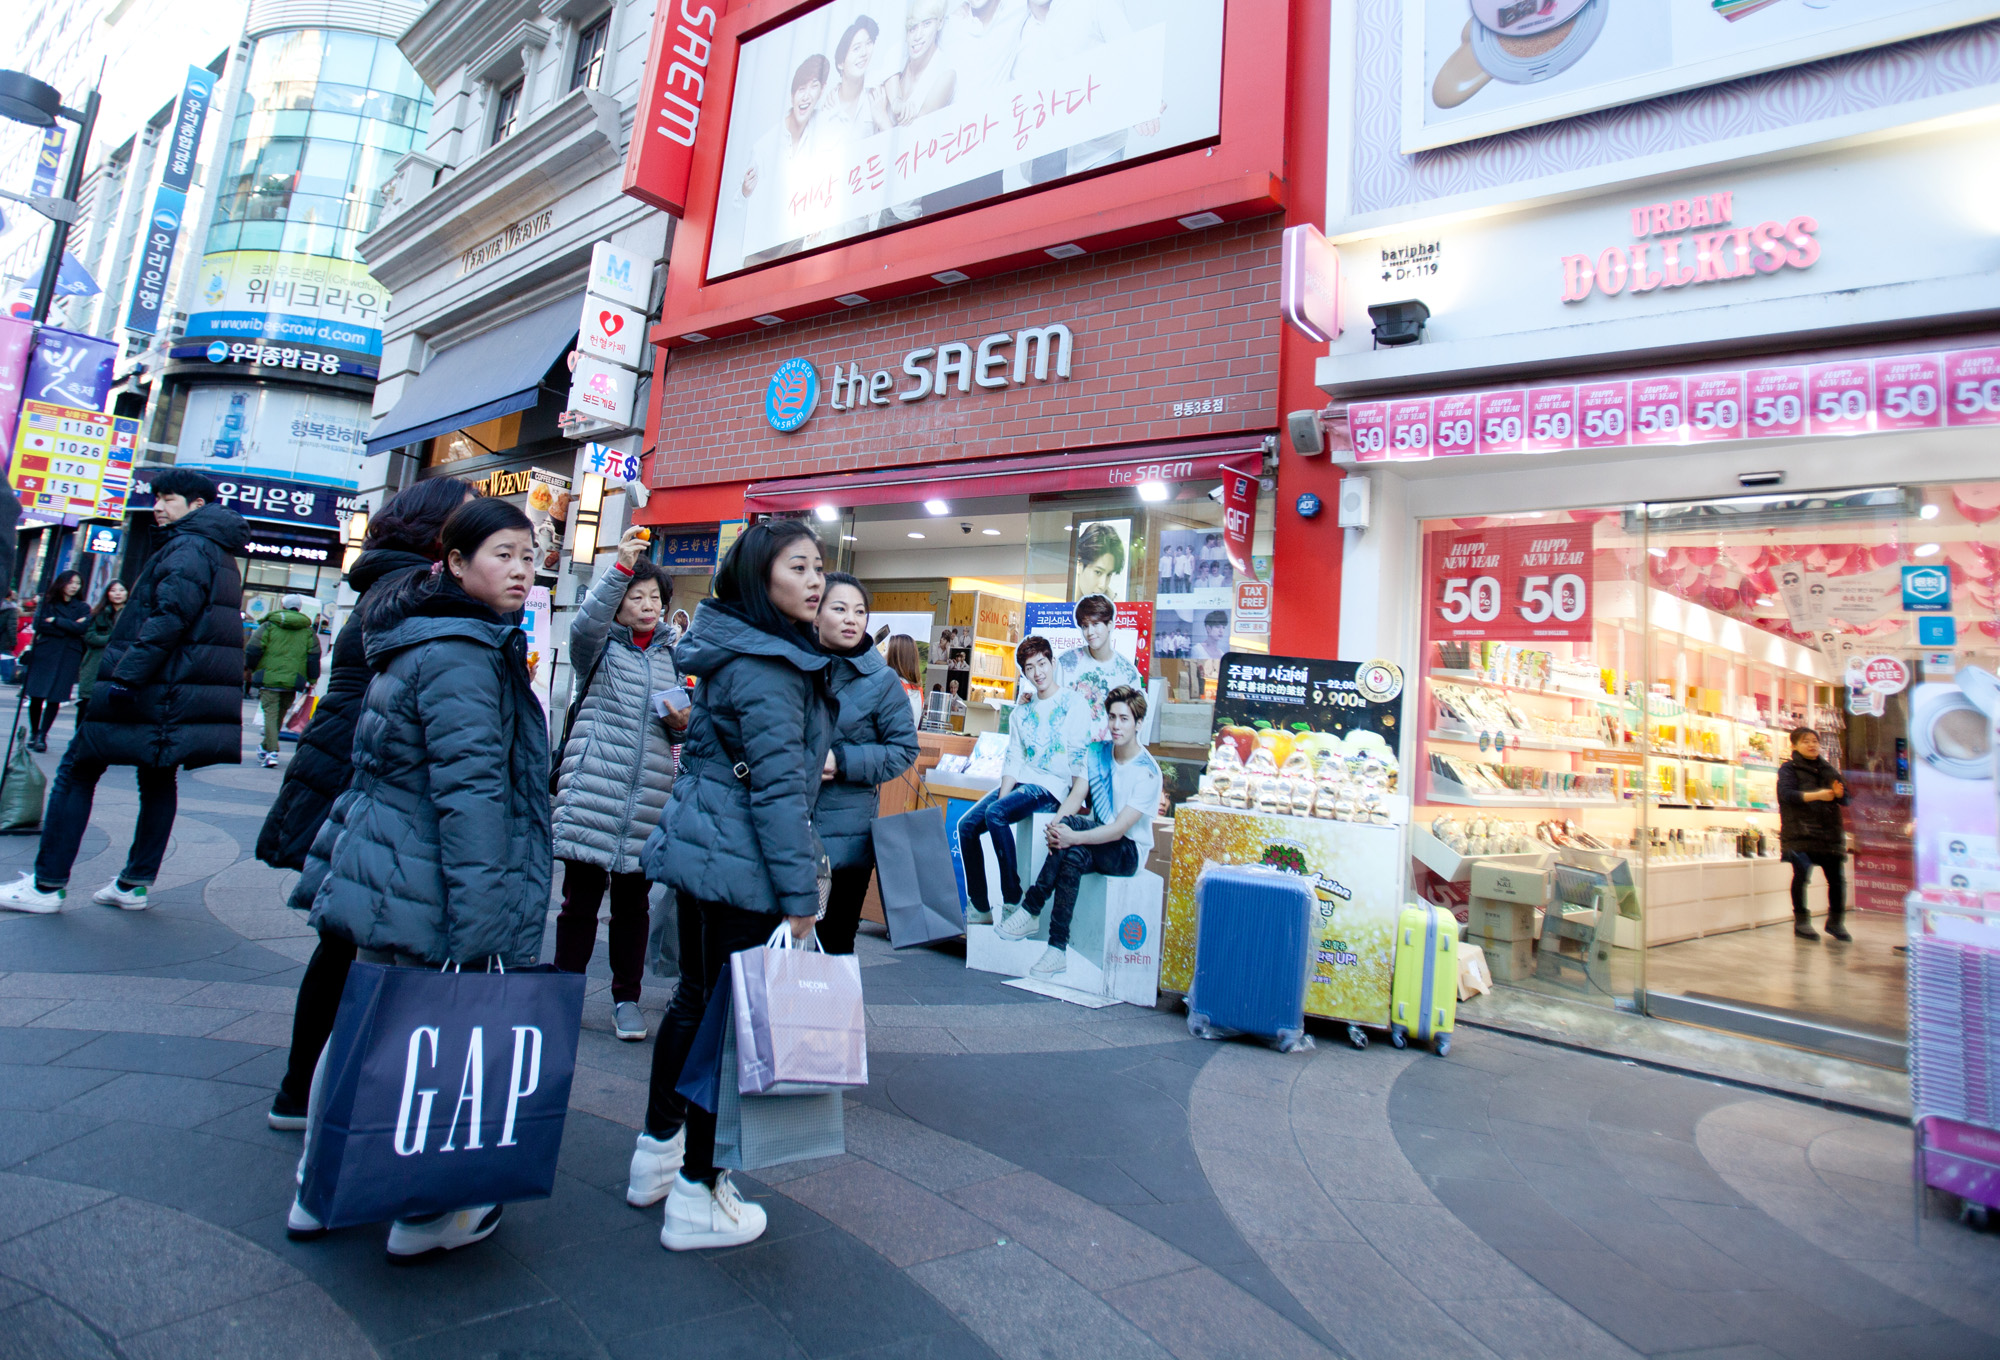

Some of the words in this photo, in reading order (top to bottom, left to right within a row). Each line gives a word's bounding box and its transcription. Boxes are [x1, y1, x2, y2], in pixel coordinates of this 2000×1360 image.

[657, 0, 716, 147] SAEM
[848, 154, 886, 195] 모든
[895, 114, 999, 179] 자연과
[1012, 74, 1101, 151] 통하다
[1630, 191, 1734, 239] URBAN
[607, 254, 631, 283] M
[1561, 216, 1821, 303] DOLLKISS
[138, 233, 171, 311] 우리은행
[1397, 263, 1438, 280] Dr.119
[246, 278, 391, 319] 위비크라우
[211, 318, 366, 345] www.wibeecrowd.com
[229, 342, 340, 376] 우리종합금융
[831, 362, 893, 411] the
[899, 324, 1074, 402] SAEM
[801, 362, 812, 378] eco
[583, 392, 617, 411] 보드게임
[1817, 390, 1866, 423] 50
[1883, 384, 1937, 418] 50
[1954, 379, 2000, 414] 50
[1173, 398, 1223, 417] 명동3호점
[1695, 400, 1738, 431] 50
[1754, 394, 1800, 427] 50
[63, 421, 105, 437] 1180
[1533, 412, 1571, 441] 50
[1584, 408, 1624, 438] 50
[1638, 404, 1680, 434] 50
[1356, 427, 1384, 453] 50
[1394, 423, 1427, 450] 50
[1438, 420, 1472, 447] 50
[1484, 416, 1521, 444] 50
[59, 441, 100, 458] 1026
[55, 462, 85, 475] 170
[1109, 469, 1132, 484] the
[1134, 461, 1193, 482] SAEM
[51, 480, 79, 495] 151
[217, 482, 316, 517] 우리은행
[1299, 501, 1315, 509] ADT
[1227, 507, 1250, 535] GIFT
[1451, 542, 1488, 556] HAPPY
[1530, 538, 1571, 552] HAPPY
[1442, 556, 1469, 569] NEW
[1471, 555, 1500, 568] YEAR
[1520, 554, 1550, 566] NEW
[1552, 552, 1584, 565] YEAR
[1244, 587, 1262, 596] TAX
[1442, 576, 1500, 623] 50
[1520, 574, 1586, 623] 50
[525, 601, 547, 609] ssage
[1241, 598, 1264, 607] FREE
[980, 611, 998, 624] SKIN
[1037, 616, 1072, 626] 크리스마스
[1115, 616, 1137, 627] 스마스
[1228, 664, 1267, 681] 주름에
[1269, 668, 1309, 684] 사과해
[1868, 671, 1901, 680] FREE
[1872, 662, 1895, 670] TAX
[1312, 690, 1367, 708] 9,900원
[1867, 862, 1896, 871] Dr.119
[1871, 897, 1907, 907] bavipha
[1124, 954, 1151, 965] SAEM
[1336, 953, 1357, 966] UP!
[799, 980, 829, 990] ENCORE
[393, 1026, 543, 1156] GAP
